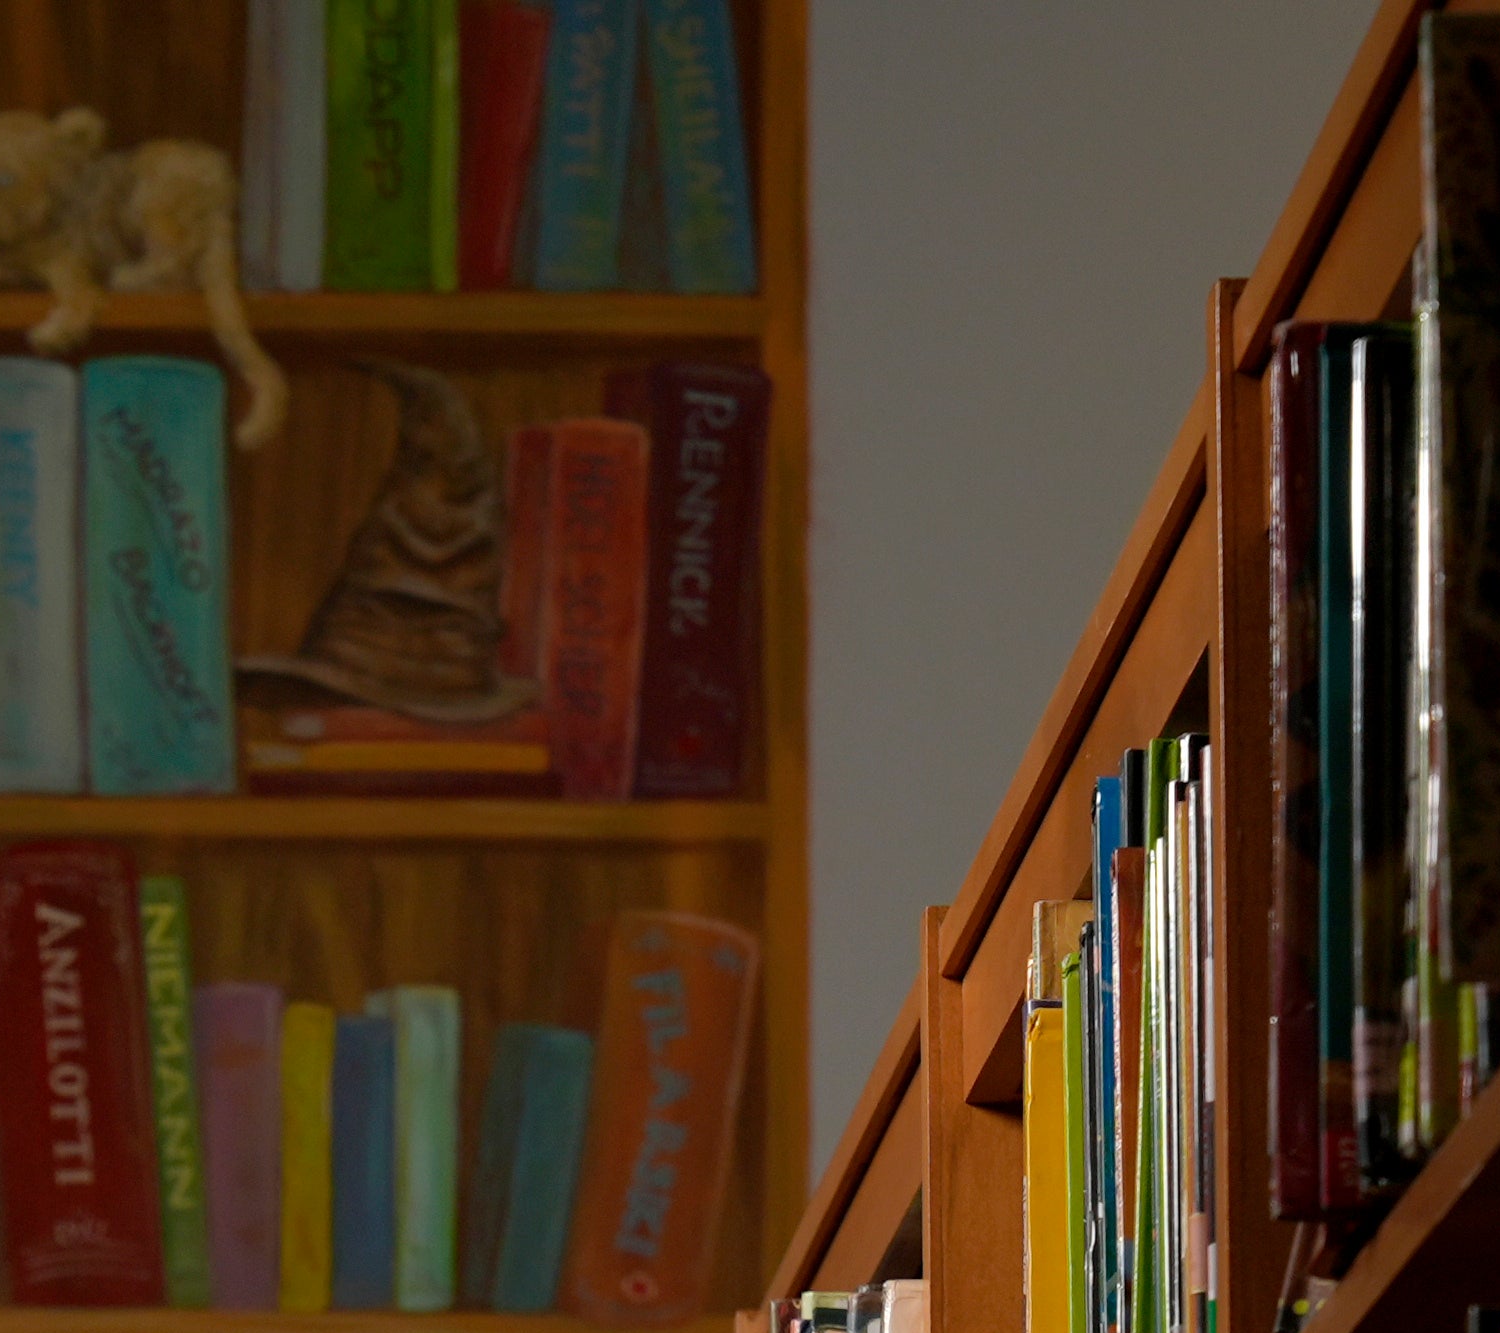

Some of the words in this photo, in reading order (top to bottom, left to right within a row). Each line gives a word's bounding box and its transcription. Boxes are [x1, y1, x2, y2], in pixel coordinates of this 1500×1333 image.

[667, 389, 739, 637] RENNICK
[33, 900, 98, 1189] ANZILOTTI
[140, 900, 199, 1211] NIEMANN
